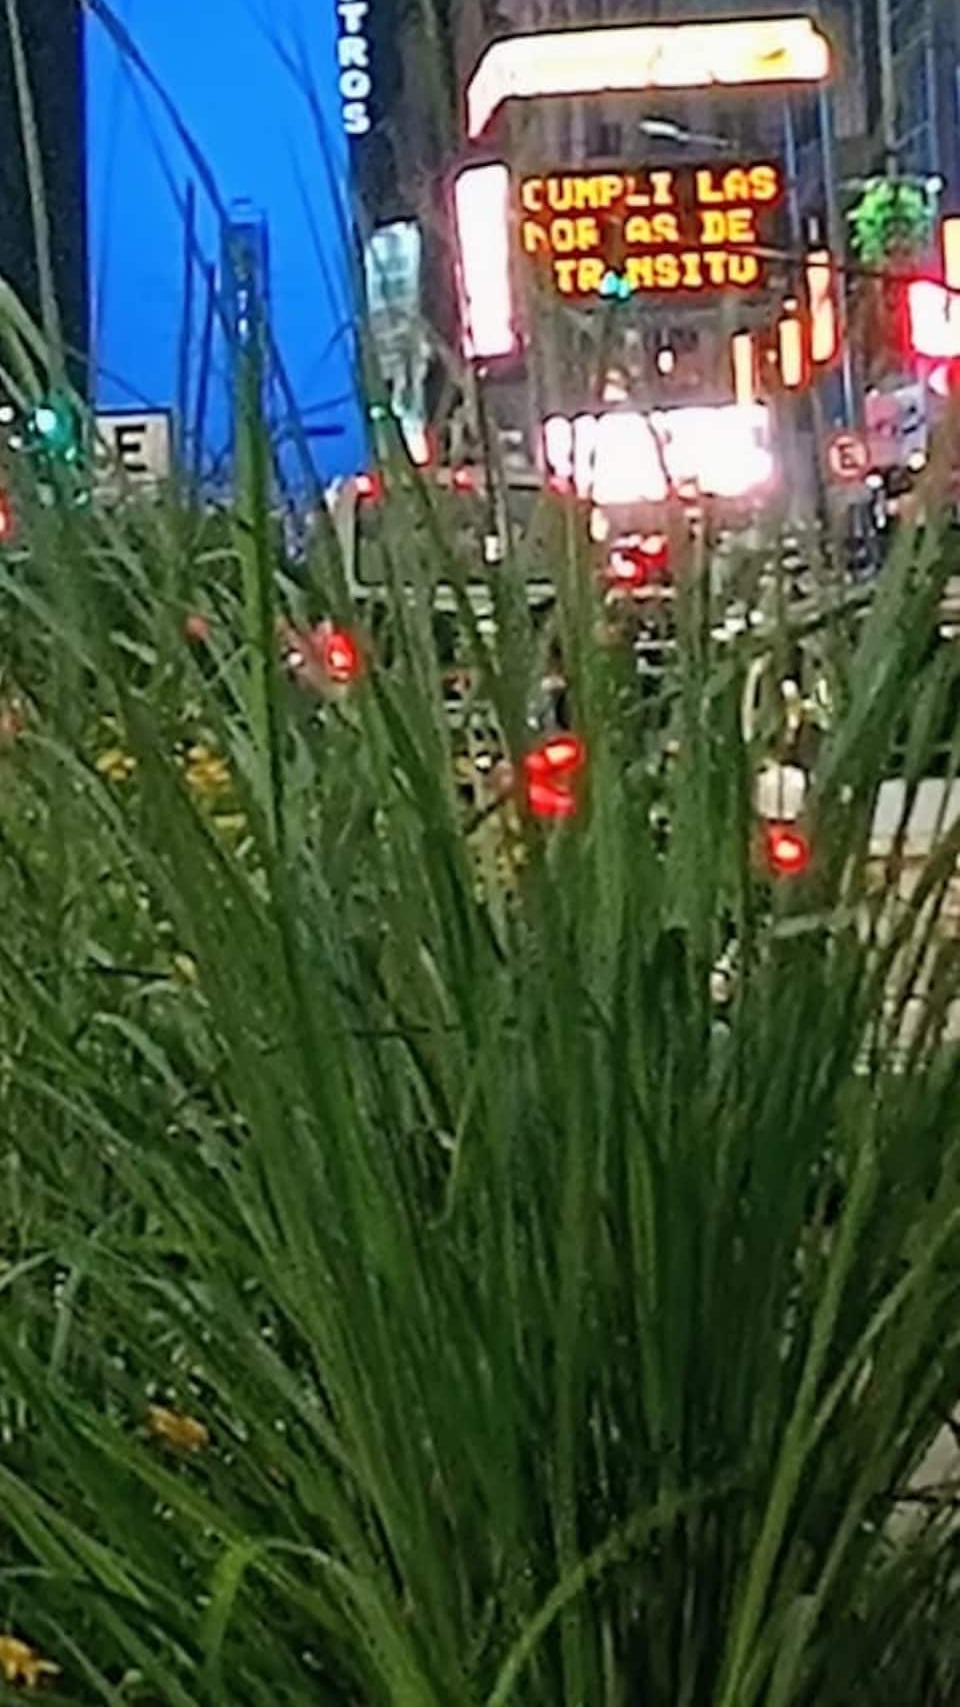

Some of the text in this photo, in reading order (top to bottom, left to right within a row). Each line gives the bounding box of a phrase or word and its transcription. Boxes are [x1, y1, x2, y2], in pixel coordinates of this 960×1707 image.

[521, 165, 778, 211] CUMPLI LAS
[522, 208, 756, 253] NORAS DE
[553, 250, 760, 293] TRNSITO
[115, 423, 148, 472] E
